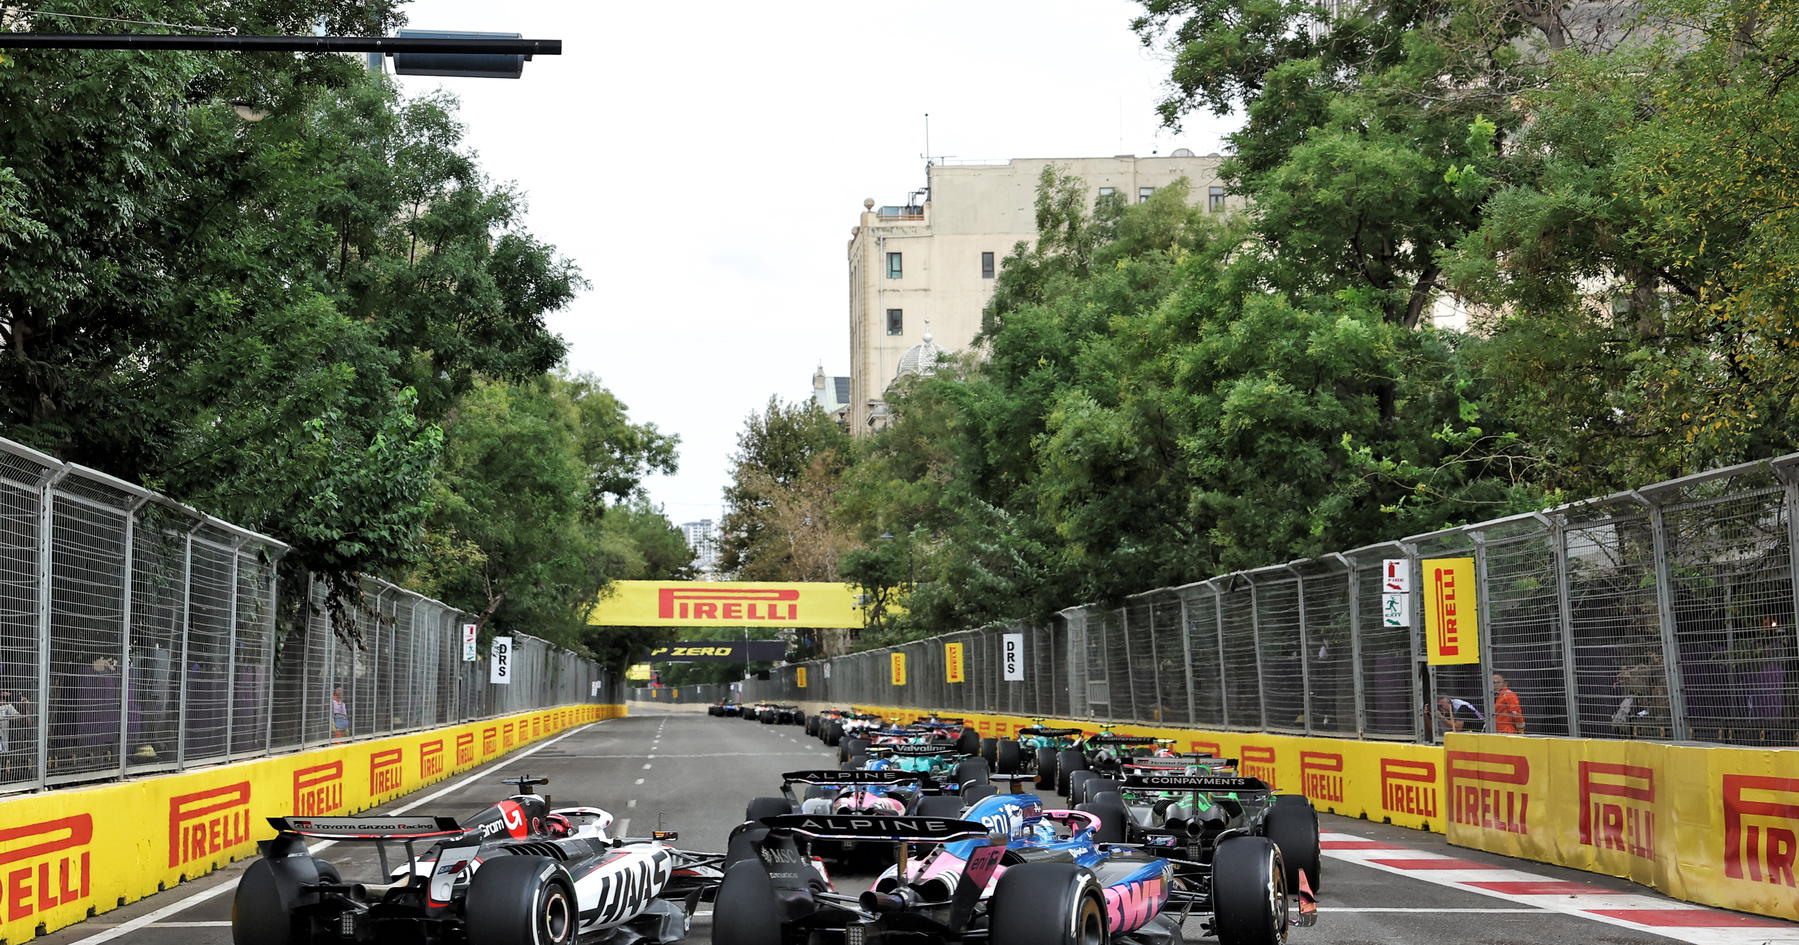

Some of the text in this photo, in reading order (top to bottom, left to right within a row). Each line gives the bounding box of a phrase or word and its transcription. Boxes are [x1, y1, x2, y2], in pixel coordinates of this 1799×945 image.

[659, 588, 800, 620] PIRELLI
[1435, 568, 1459, 656] PIRELLI
[498, 643, 507, 676] DRS
[671, 647, 732, 656] ZERO
[1007, 641, 1015, 673] DRS
[420, 739, 444, 779] PIRELLI
[457, 732, 474, 766] PIRELLI
[293, 760, 343, 816] PIRELLI
[370, 748, 402, 796] PIRELLI
[1151, 777, 1245, 785] COINPAYMENTS
[1300, 751, 1344, 803] PIRELLI
[1381, 758, 1437, 818] PIRELLI
[1447, 750, 1529, 835] PIRELLI
[1578, 760, 1655, 862] PIRELLI
[169, 781, 251, 869] PIRELLI
[801, 818, 948, 831] ALPINE
[981, 807, 1008, 834] eni
[770, 848, 797, 863] MSC
[1102, 878, 1162, 934] BWT
